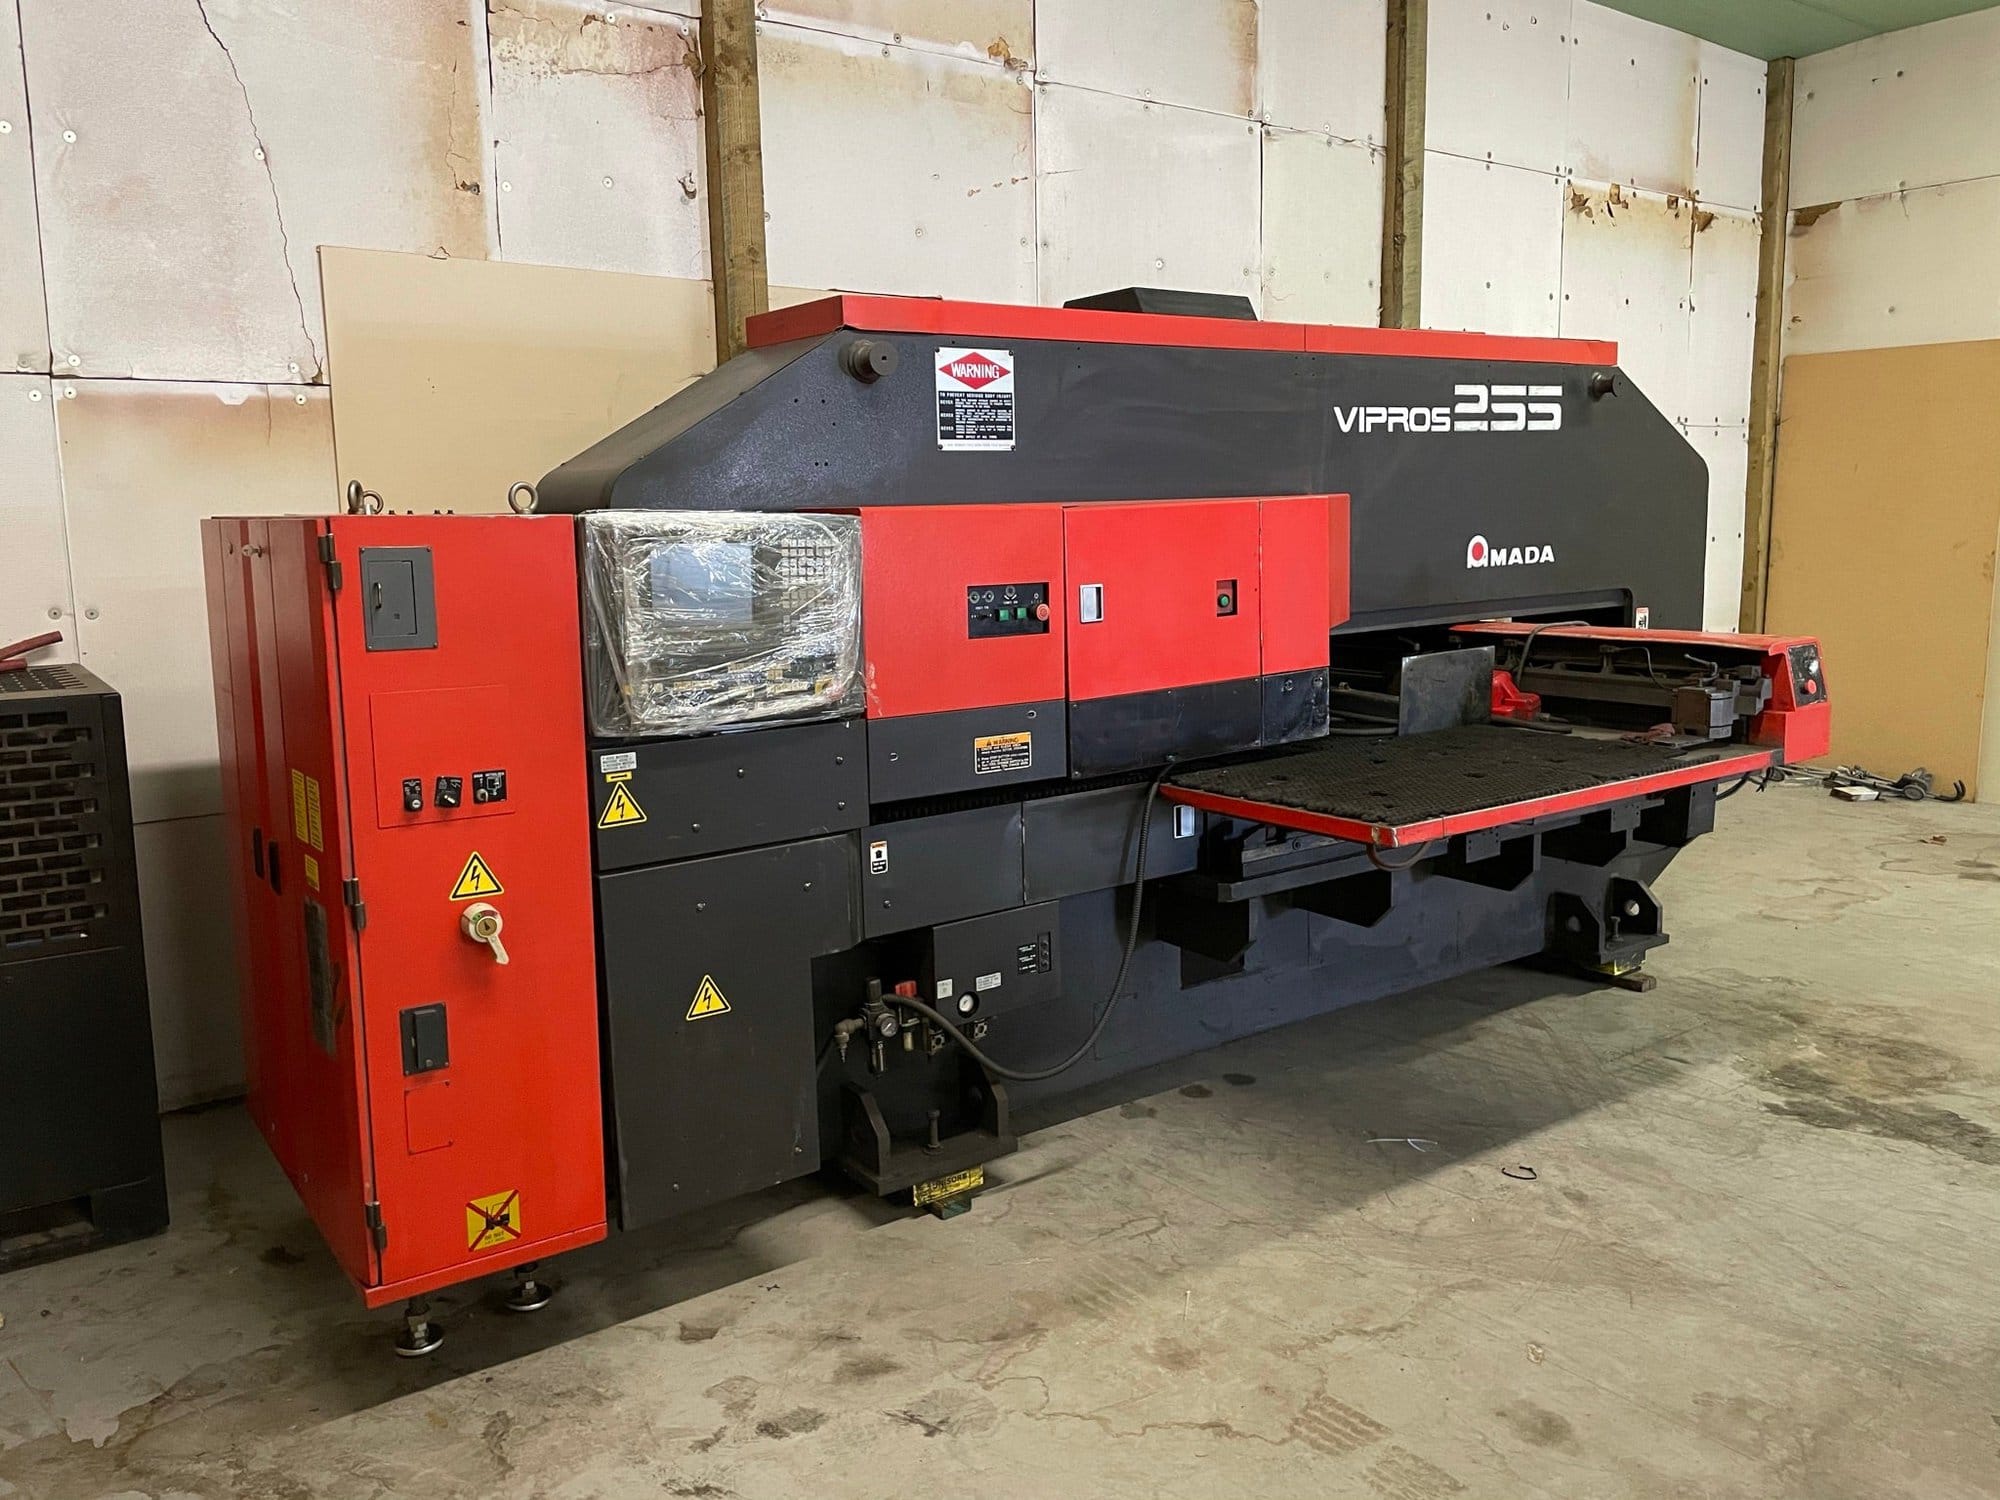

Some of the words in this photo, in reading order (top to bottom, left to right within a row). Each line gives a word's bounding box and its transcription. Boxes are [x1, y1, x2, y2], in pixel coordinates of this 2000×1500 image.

[951, 363, 1000, 378] WARNING
[1466, 534, 1555, 569] AMADA
[993, 737, 1020, 745] WARNING
